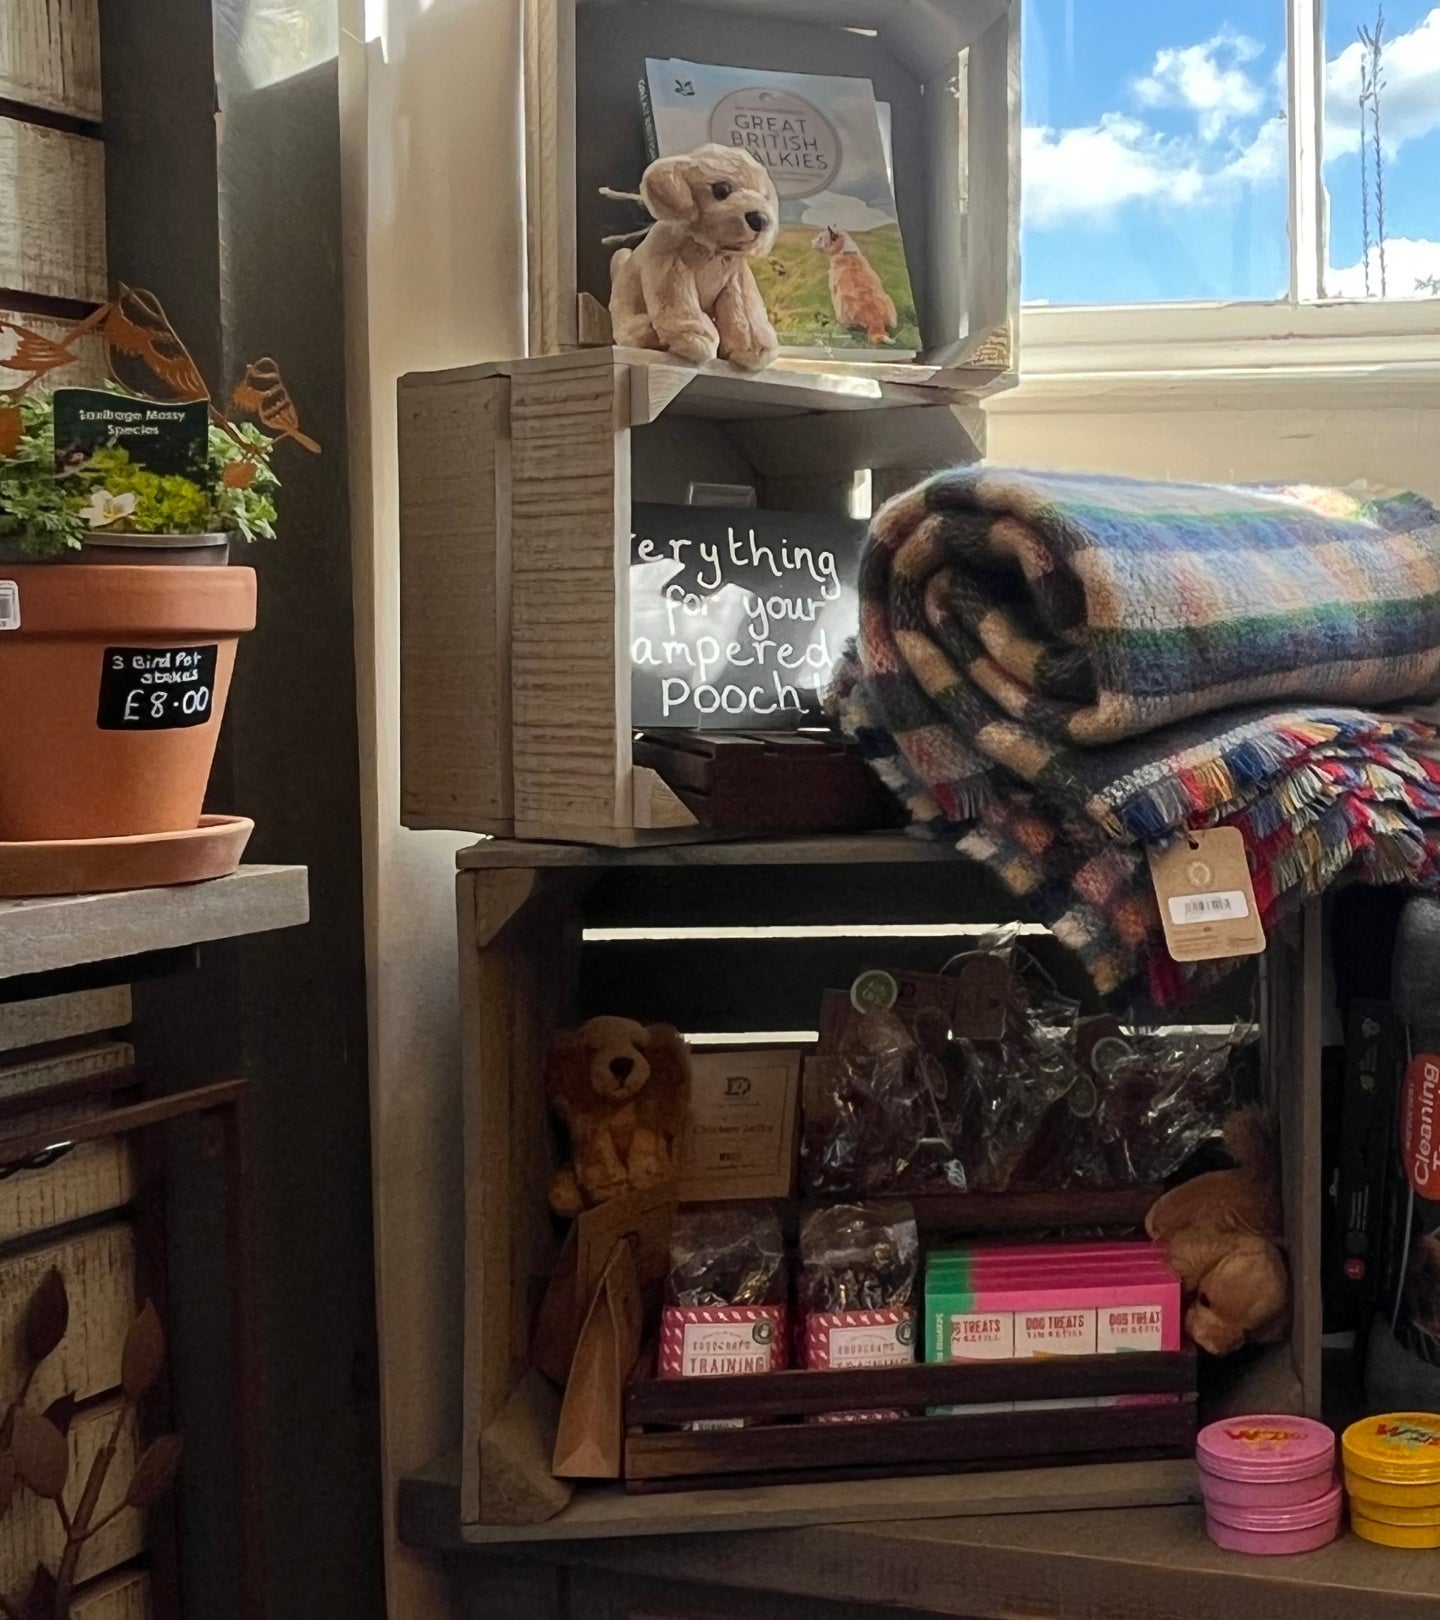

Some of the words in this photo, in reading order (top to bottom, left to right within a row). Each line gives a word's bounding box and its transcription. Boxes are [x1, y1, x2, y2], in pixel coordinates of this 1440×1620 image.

[734, 114, 807, 135] GREAT
[731, 130, 818, 152] BRITISH
[745, 147, 829, 170] ALKIES
[107, 424, 160, 438] Species
[631, 527, 842, 600] erything
[665, 584, 720, 636] for
[742, 594, 827, 641] your
[111, 655, 125, 670] 3
[132, 652, 171, 669] Bird
[175, 651, 203, 668] Pot
[631, 629, 834, 683] ampered
[123, 685, 210, 721] £8.00
[1413, 1062, 1440, 1186] Cleaning
[963, 1319, 1001, 1335] TREATS
[1047, 1315, 1085, 1330] TREATS
[1131, 1311, 1161, 1325] TREAT
[690, 1356, 765, 1374] TRAINING
